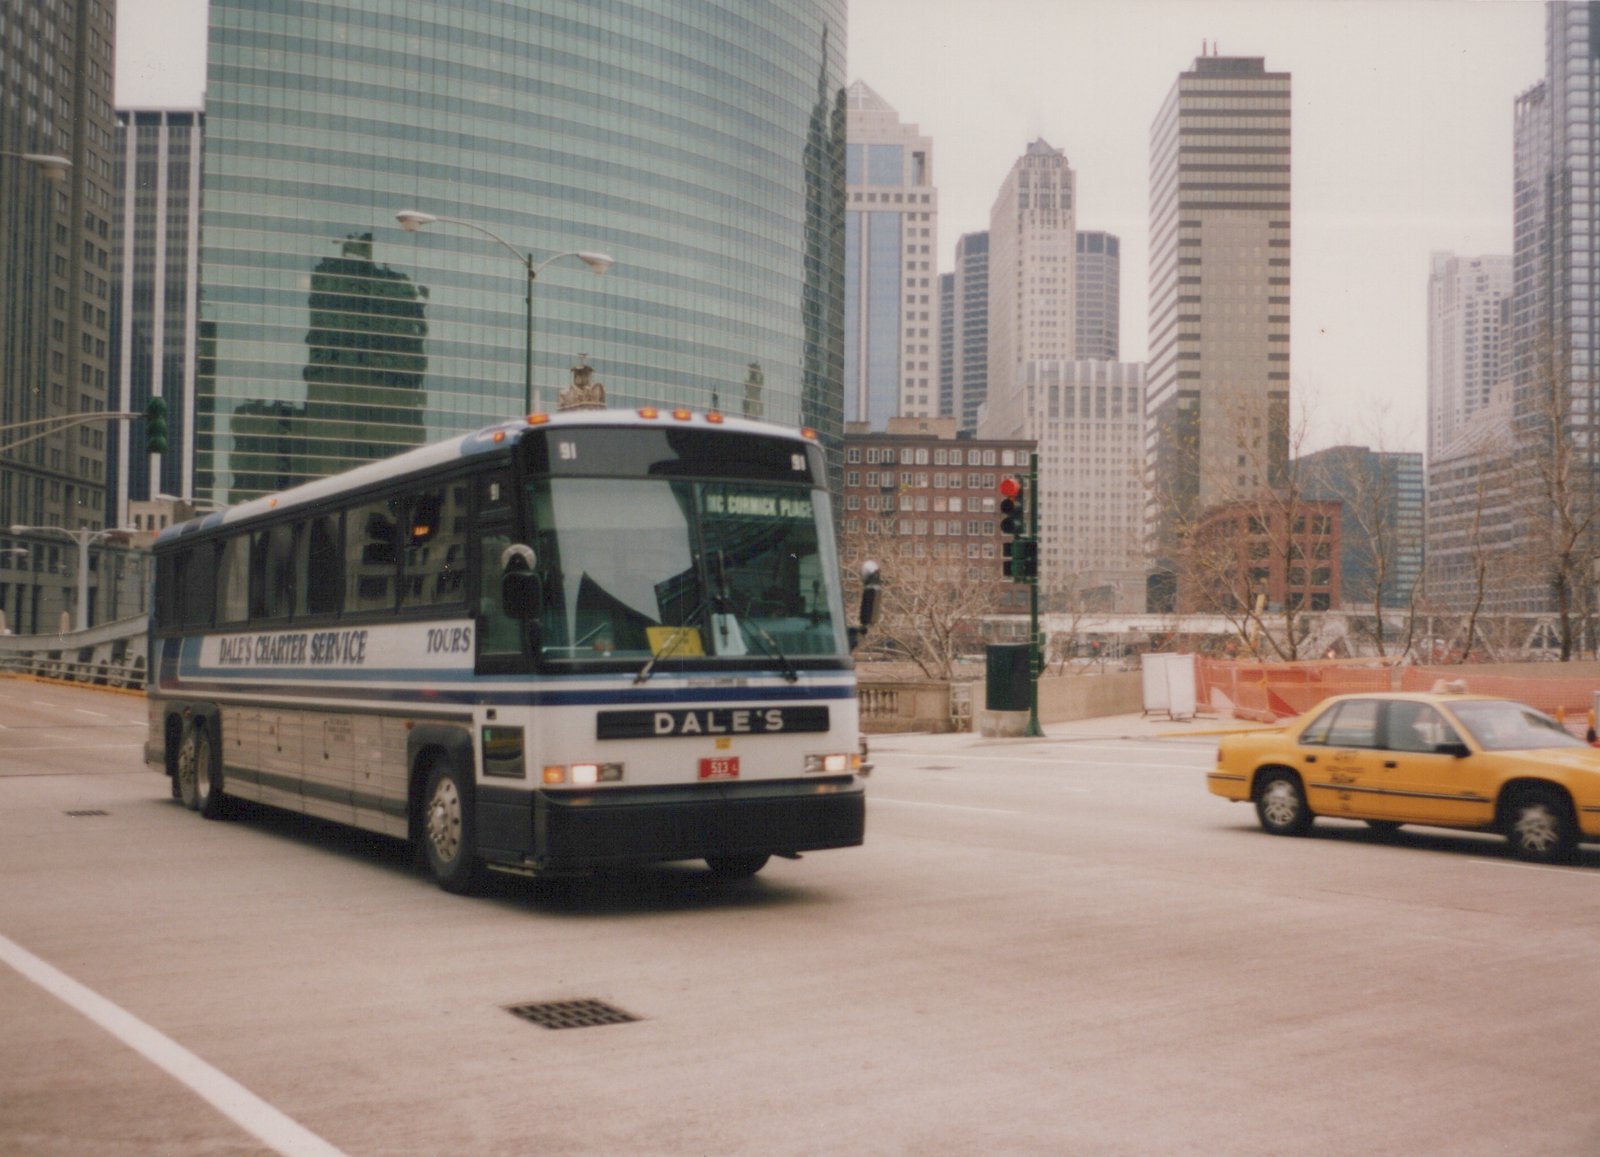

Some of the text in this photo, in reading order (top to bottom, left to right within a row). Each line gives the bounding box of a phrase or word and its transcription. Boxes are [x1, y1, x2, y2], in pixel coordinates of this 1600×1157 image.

[560, 442, 577, 460] 91
[791, 454, 806, 471] 91
[219, 629, 368, 665] DALE'S CHARTER SERVICE
[427, 627, 472, 654] TOURS
[653, 709, 785, 735] DALE'S
